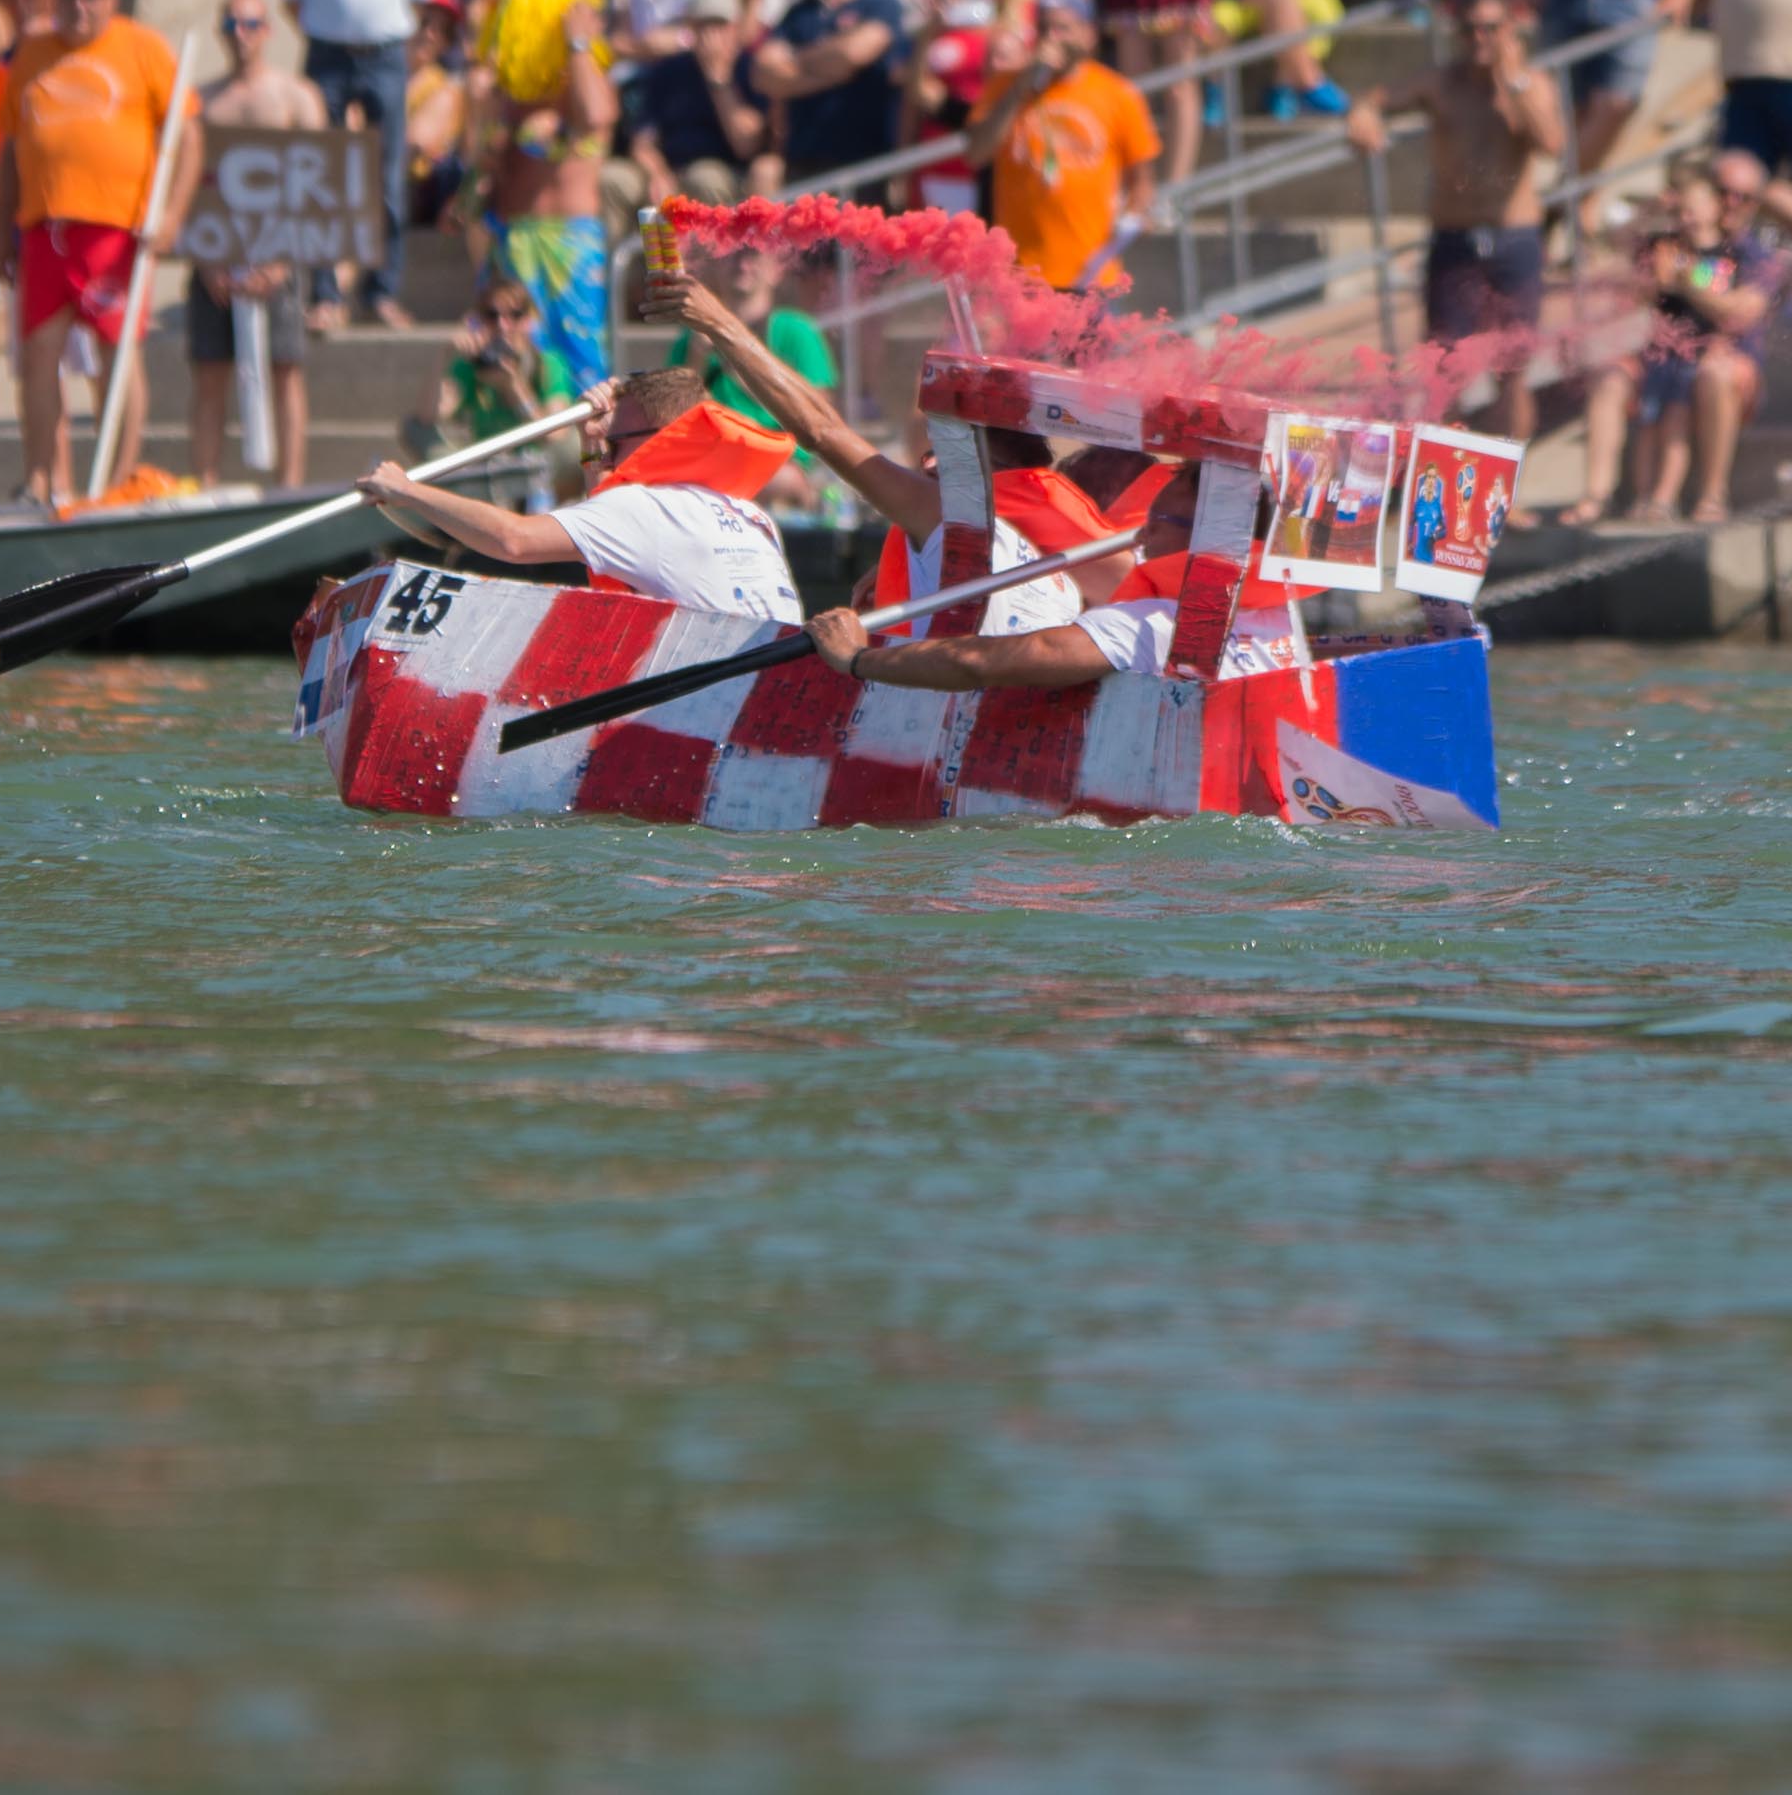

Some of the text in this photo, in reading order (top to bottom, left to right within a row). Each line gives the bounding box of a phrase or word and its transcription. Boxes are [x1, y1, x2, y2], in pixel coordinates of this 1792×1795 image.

[216, 140, 367, 212] CRI
[175, 210, 377, 266] OVANI
[385, 568, 467, 636] 45
